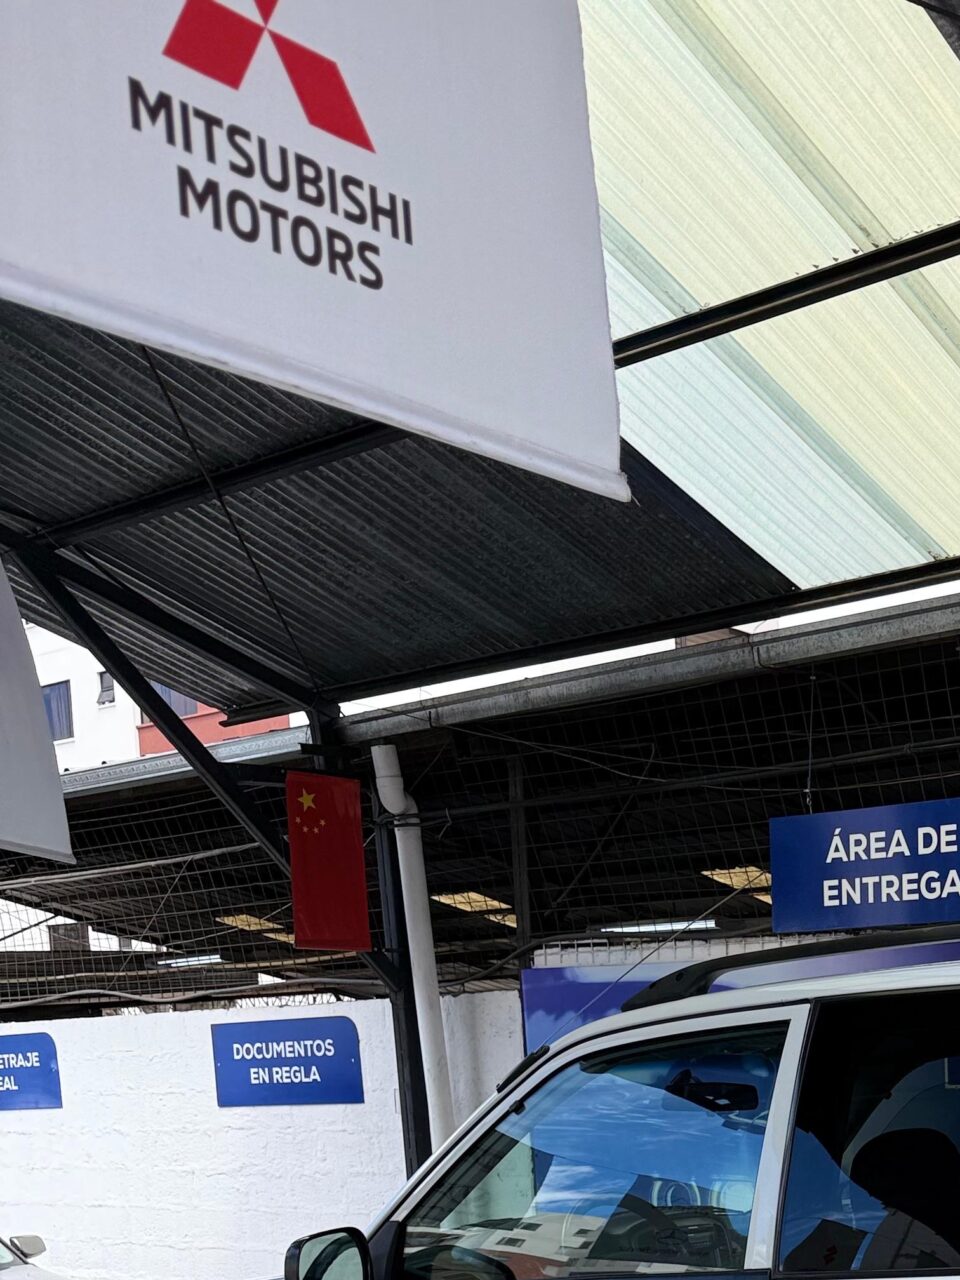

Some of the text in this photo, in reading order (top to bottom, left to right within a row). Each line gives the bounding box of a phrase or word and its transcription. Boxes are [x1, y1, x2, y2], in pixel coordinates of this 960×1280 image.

[128, 77, 413, 246] MITSUBISHI
[177, 165, 383, 290] MOTORS
[826, 823, 958, 864] ÁREA DE
[232, 1039, 335, 1060] DOCUMENTOS
[250, 1065, 321, 1085] EN REGLA
